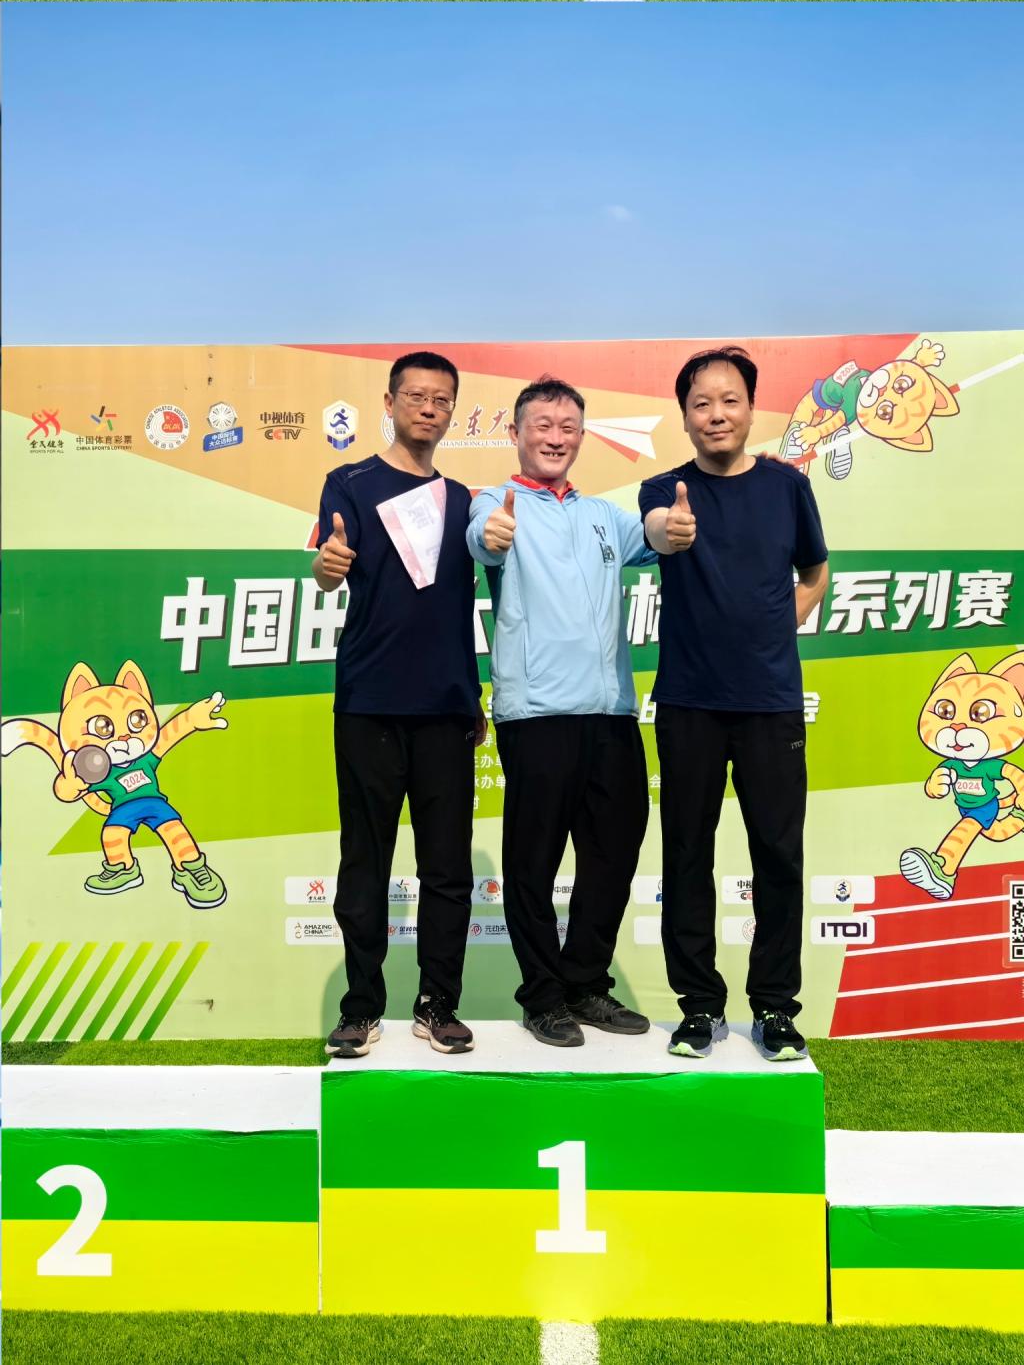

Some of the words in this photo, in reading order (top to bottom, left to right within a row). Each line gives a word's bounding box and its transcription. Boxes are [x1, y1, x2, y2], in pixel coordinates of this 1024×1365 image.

[260, 412, 305, 424] 中视体育
[76, 436, 132, 445] 中国体育彩票
[265, 429, 301, 440] CCTV
[800, 570, 1013, 634] 系列赛
[123, 772, 146, 789] 2024
[957, 781, 981, 791] 2024
[821, 923, 867, 937] ITOI
[535, 1141, 606, 1253] 1
[37, 1165, 112, 1276] 2
